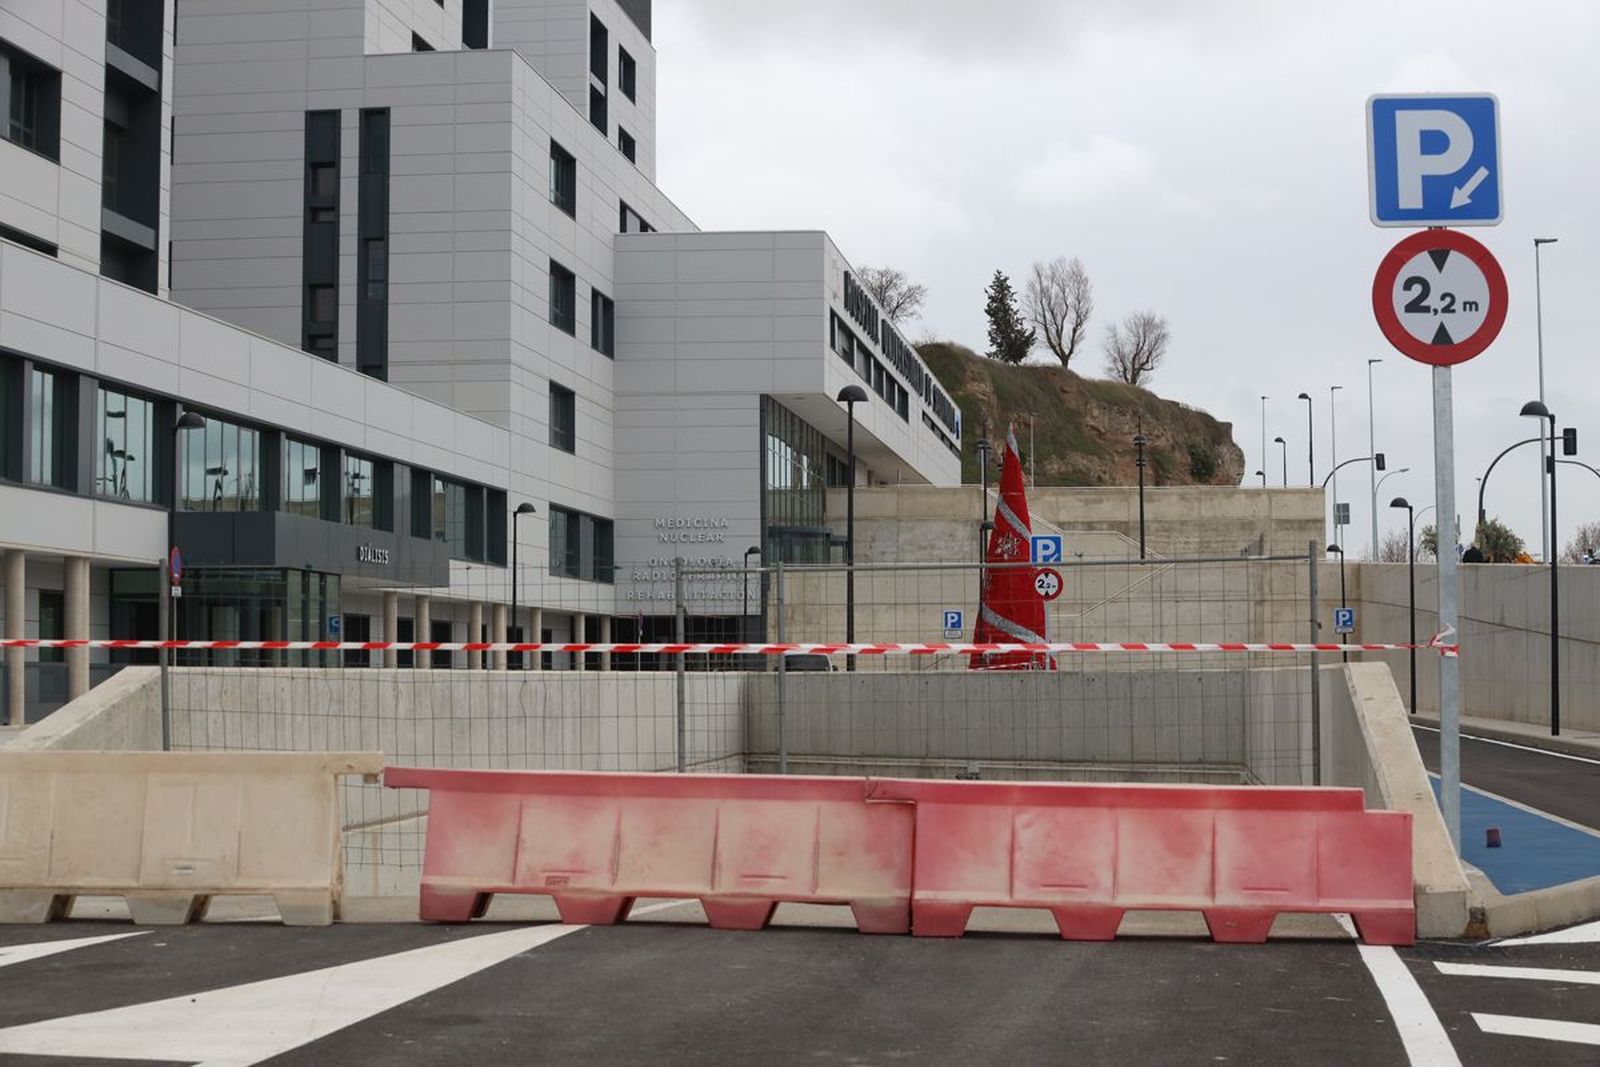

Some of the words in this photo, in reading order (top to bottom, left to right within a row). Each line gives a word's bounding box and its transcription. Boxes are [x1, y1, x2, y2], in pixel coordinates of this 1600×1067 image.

[1395, 109, 1474, 210] P
[1402, 275, 1456, 317] 2,2
[1463, 297, 1479, 312] m
[656, 518, 728, 528] MEDICINA
[659, 531, 725, 543] NUCLEAR
[1037, 539, 1056, 563] P
[947, 613, 958, 627] P
[1339, 610, 1350, 626] P
